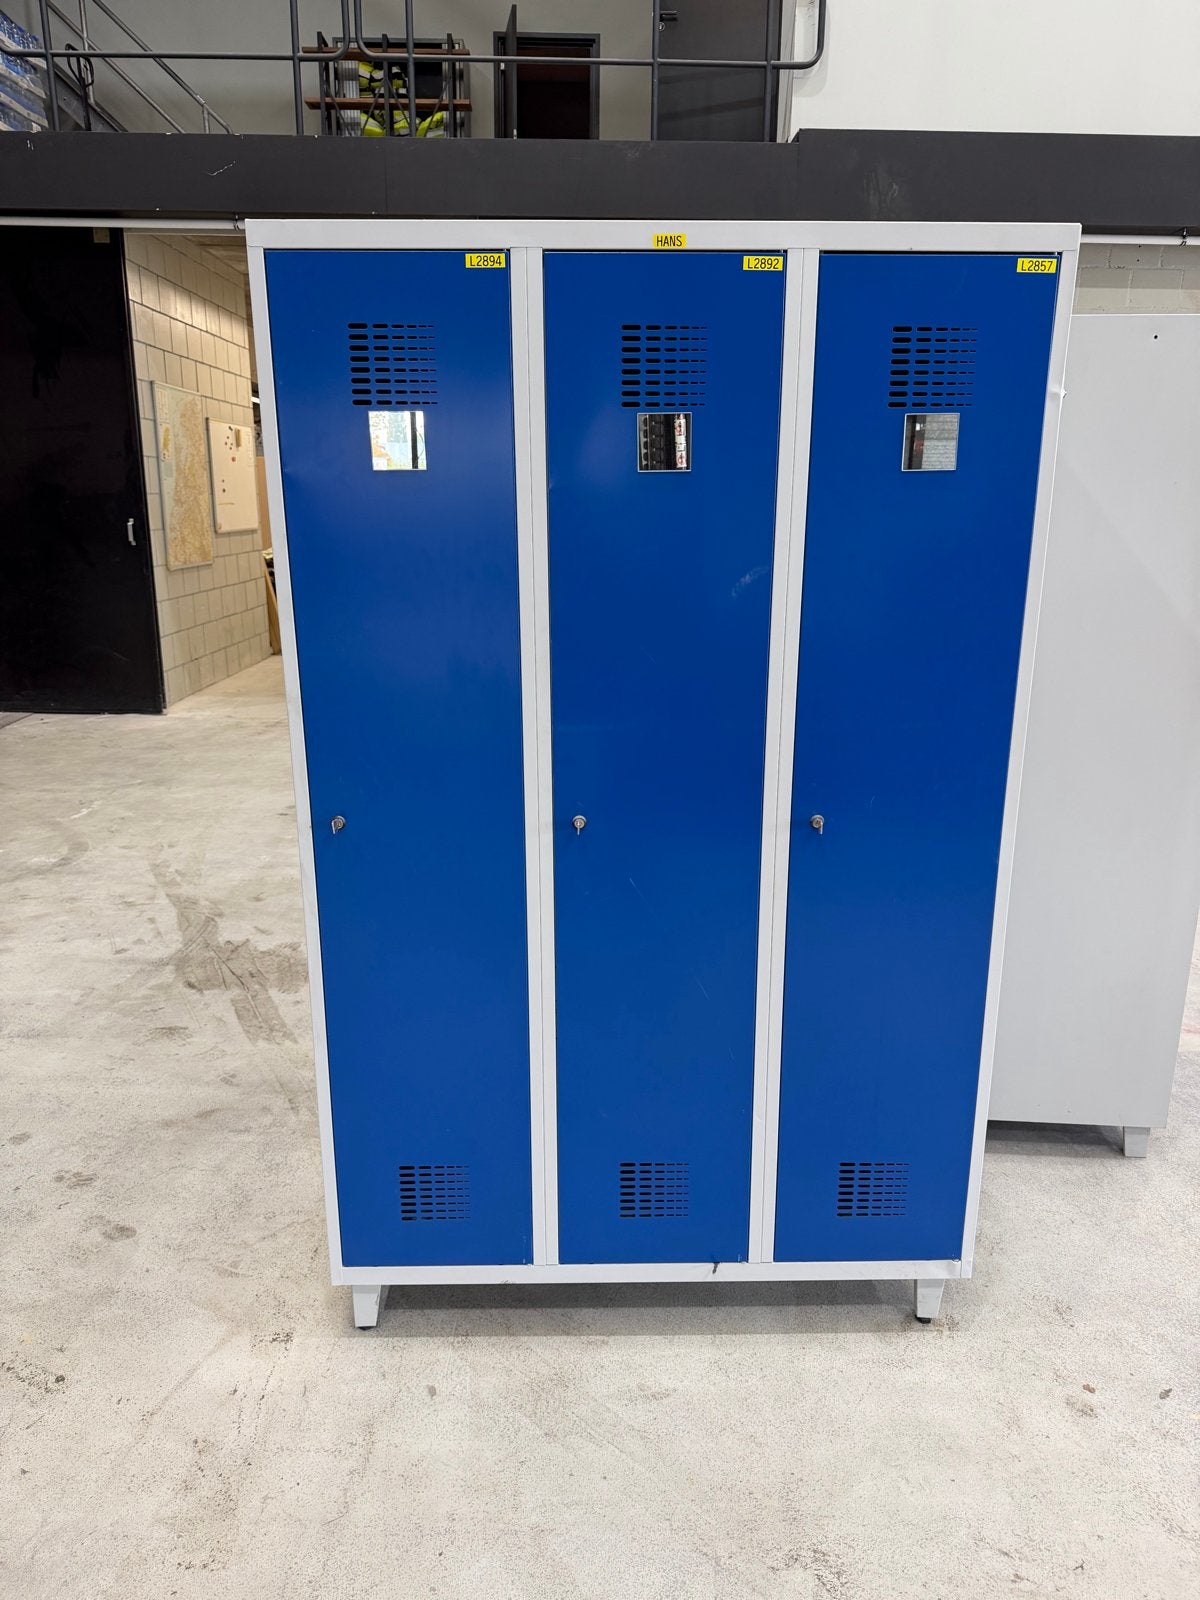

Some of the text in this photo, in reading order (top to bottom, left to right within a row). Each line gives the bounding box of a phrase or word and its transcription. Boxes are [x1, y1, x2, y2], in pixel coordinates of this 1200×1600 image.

[656, 235, 683, 247] HANS
[469, 255, 502, 267] L2894
[747, 257, 780, 270] L2892
[1021, 259, 1053, 272] L2857
